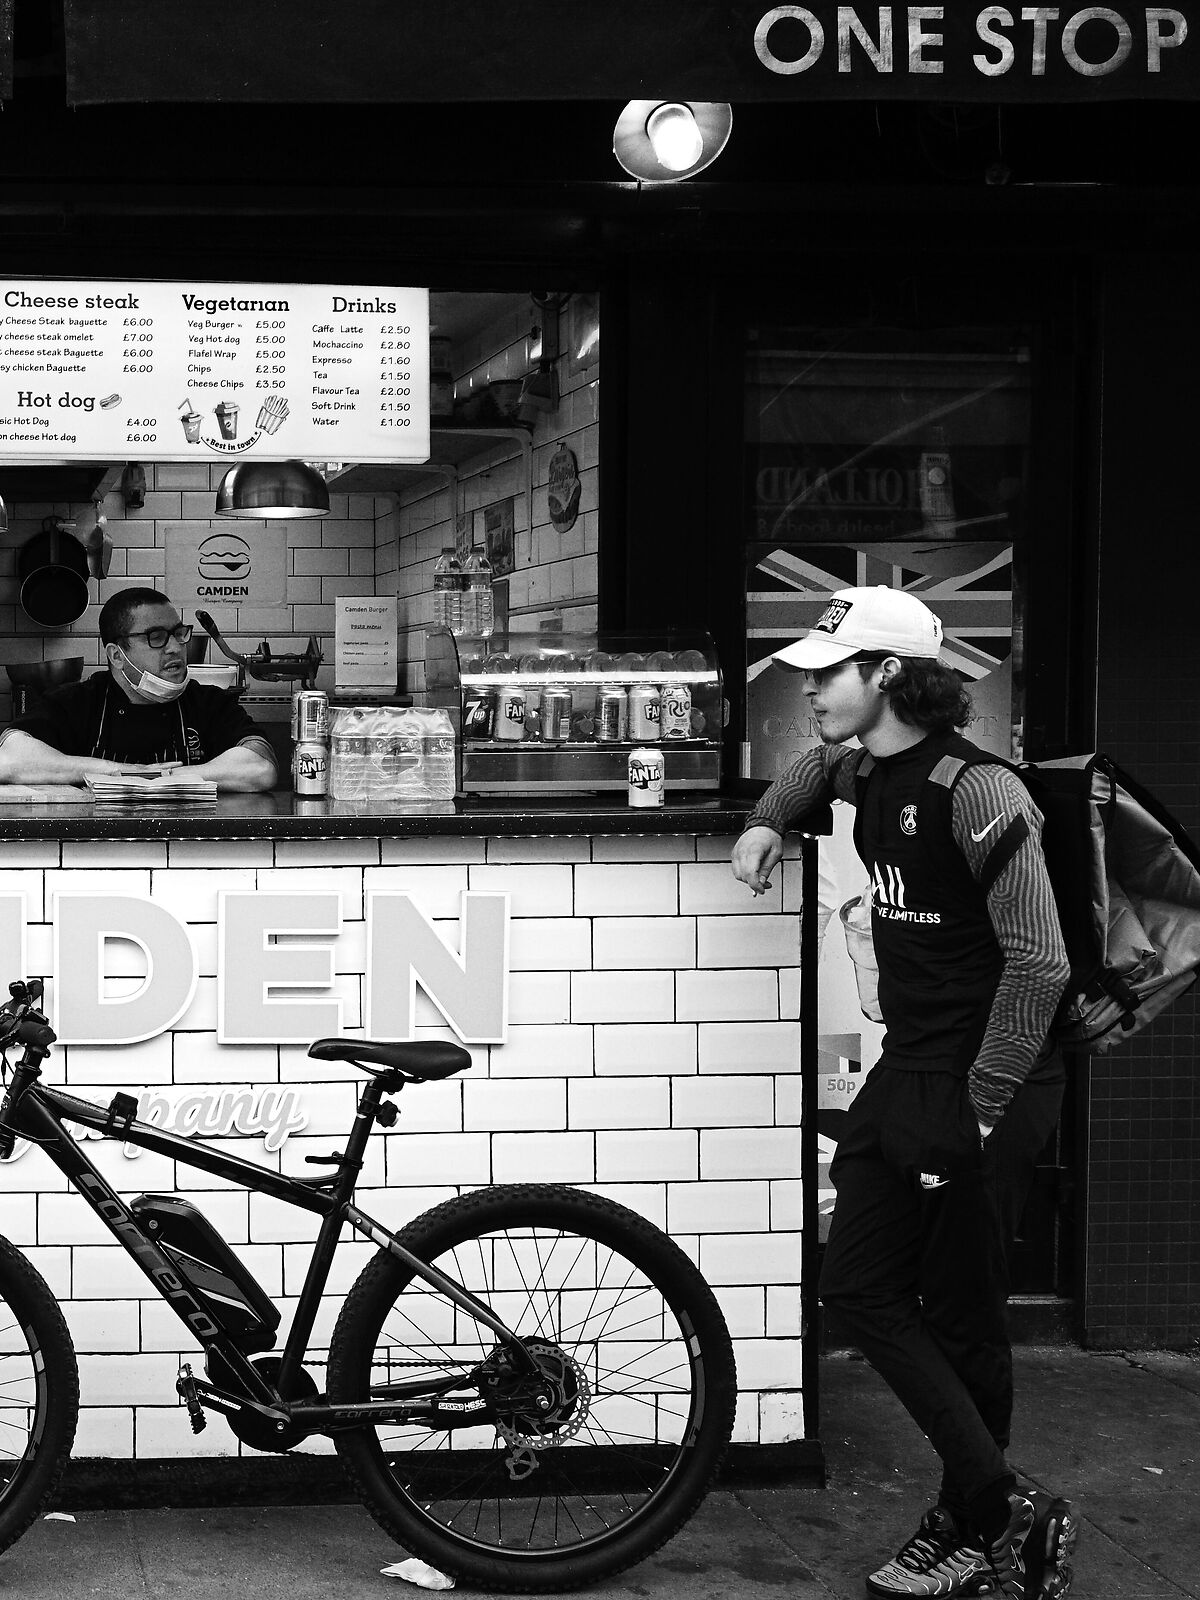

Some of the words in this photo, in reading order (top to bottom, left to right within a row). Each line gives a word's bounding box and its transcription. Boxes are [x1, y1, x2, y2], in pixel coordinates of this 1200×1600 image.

[754, 5, 945, 76] ONE
[973, 5, 1188, 77] STOP
[5, 291, 78, 308] Cheese
[86, 293, 139, 308] steak
[182, 295, 289, 314] Vegetarian
[333, 297, 396, 313] Drinks
[312, 325, 334, 333] Caffe
[341, 325, 363, 333] Latte
[381, 326, 410, 334] £2.50
[5, 332, 34, 340] cheese
[64, 333, 94, 341] omelet
[189, 335, 203, 344] Veg
[225, 336, 240, 345] dog
[313, 356, 352, 366] Expresso
[47, 364, 86, 373] Baguette
[188, 364, 211, 375] Chips
[256, 365, 285, 373] £2.50
[18, 392, 51, 407] Hot
[58, 392, 95, 412] dog
[60, 433, 76, 443] dog
[127, 434, 156, 442] £6.00
[211, 438, 227, 451] Best
[237, 437, 256, 450] town
[197, 586, 248, 596] CAMDEN
[827, 1078, 856, 1094] 50p
